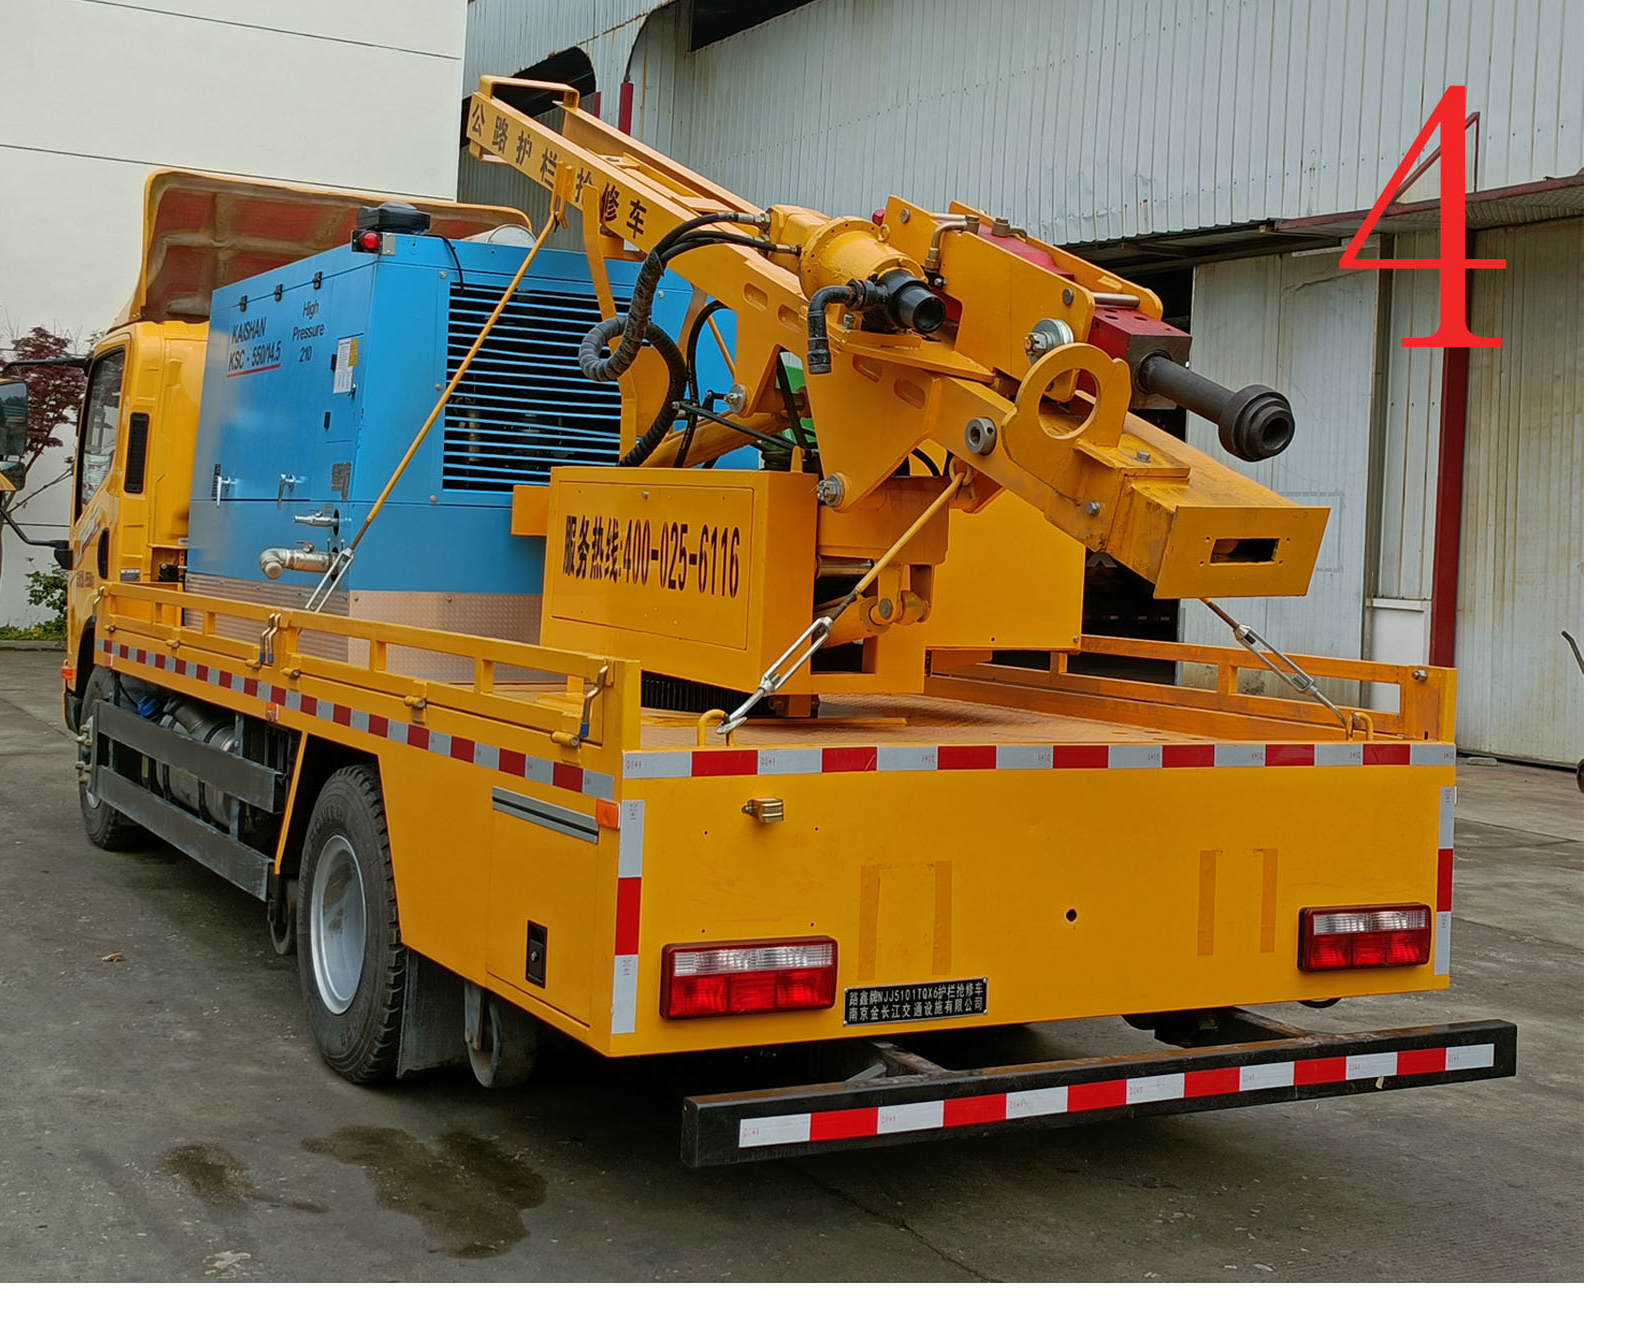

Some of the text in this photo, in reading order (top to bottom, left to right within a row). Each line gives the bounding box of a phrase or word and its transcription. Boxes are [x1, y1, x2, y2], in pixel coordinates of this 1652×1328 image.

[302, 299, 319, 320] High
[231, 316, 267, 345] KAISHAN
[292, 323, 325, 342] Pressure
[299, 345, 313, 363] 210
[562, 514, 740, 598] 服务热线:400-025-6116
[848, 996, 984, 1022] 南京金长江交通设施有限公司
